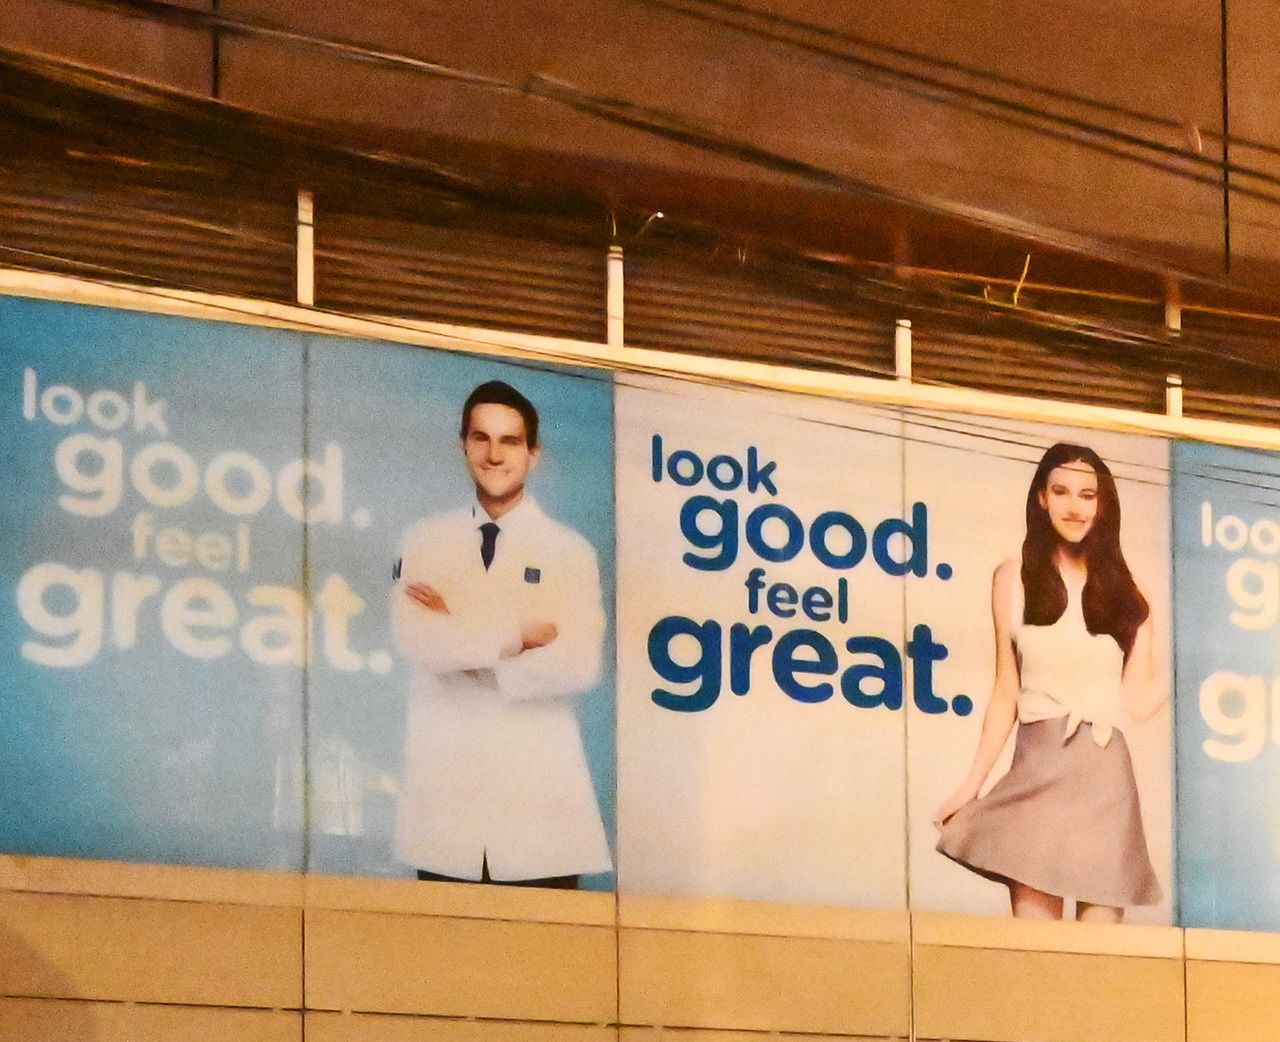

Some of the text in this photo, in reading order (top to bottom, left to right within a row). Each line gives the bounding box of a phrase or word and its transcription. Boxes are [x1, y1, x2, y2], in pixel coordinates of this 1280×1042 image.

[23, 366, 169, 436] look
[55, 433, 373, 529] good.
[651, 433, 778, 496] look
[131, 511, 252, 572] feel
[679, 494, 953, 581] good.
[16, 562, 394, 675] great.
[744, 567, 849, 624] feel
[646, 615, 974, 717] great.
